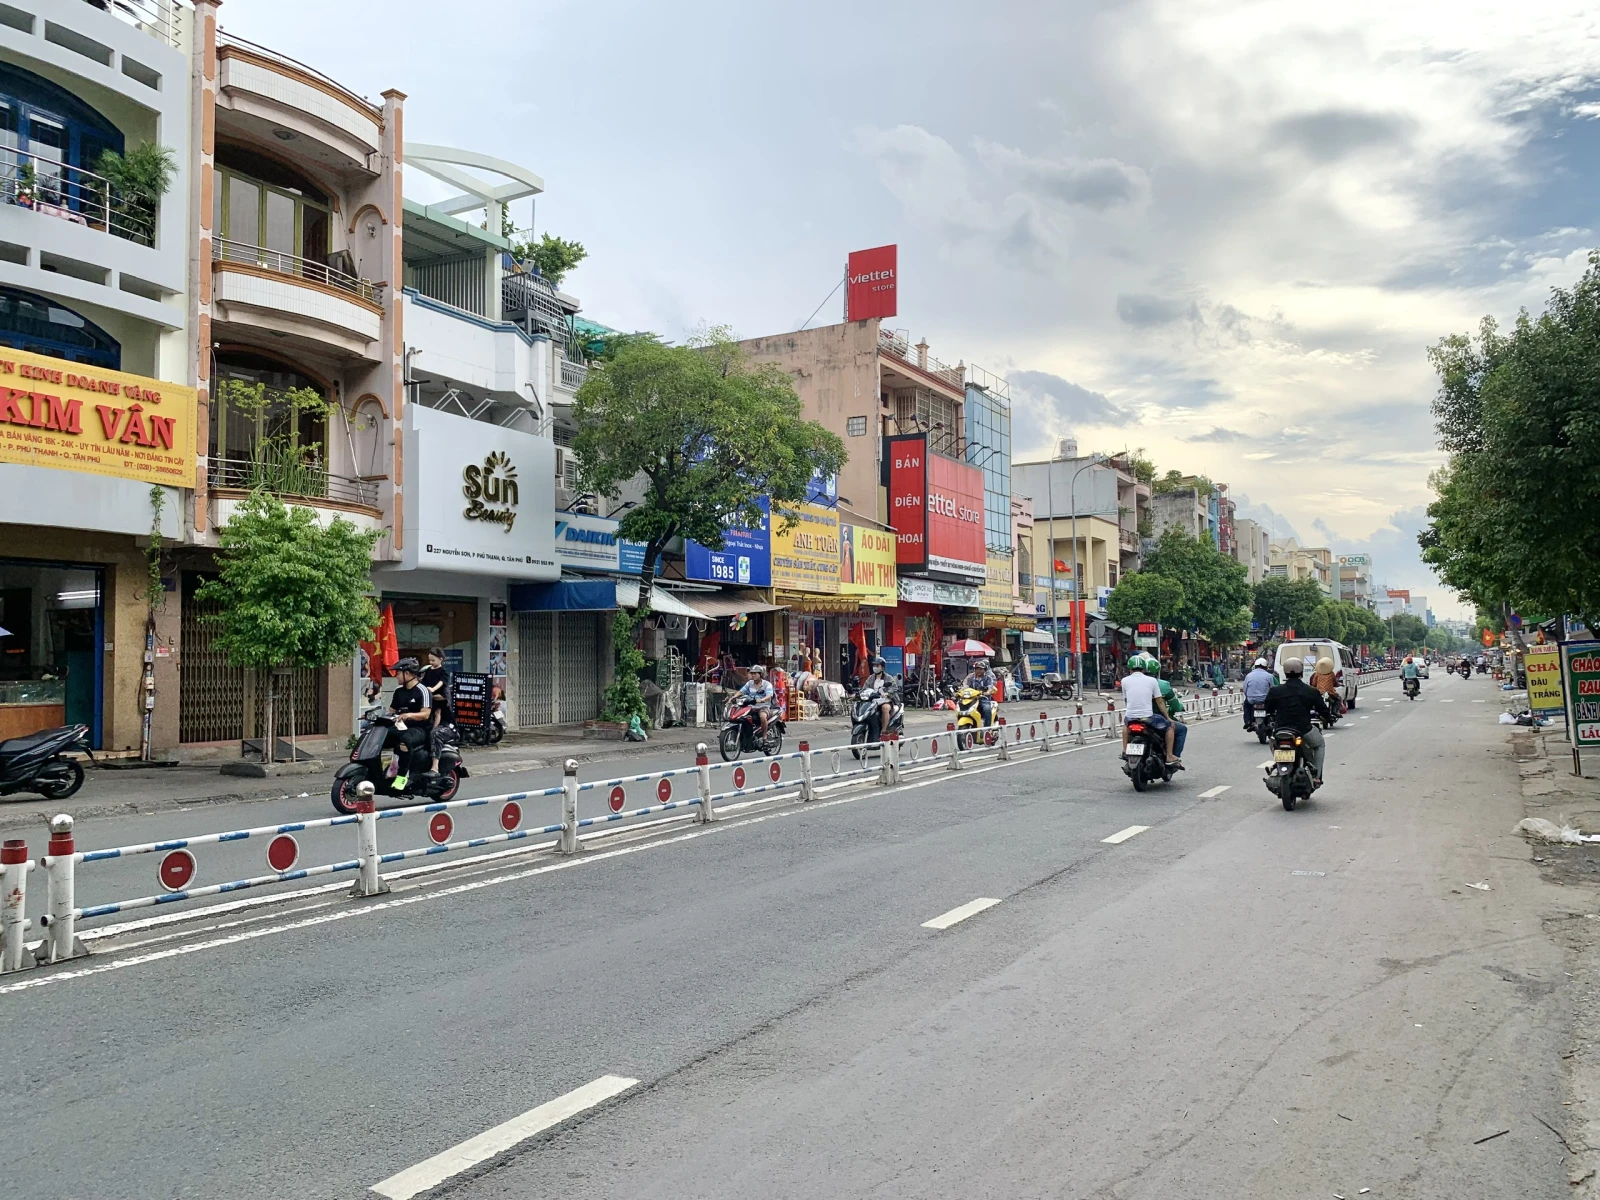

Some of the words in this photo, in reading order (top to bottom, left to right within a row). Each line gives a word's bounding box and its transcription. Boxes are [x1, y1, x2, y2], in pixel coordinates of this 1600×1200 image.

[849, 269, 895, 285] viettel
[872, 283, 895, 292] store
[21, 364, 63, 384] KINH
[67, 373, 120, 396] DOANH
[125, 384, 162, 404] VÀNG
[0, 386, 83, 435] KIM
[96, 403, 177, 450] VÂN
[6, 431, 22, 440] BÁN
[23, 432, 43, 443] VÀNG
[61, 440, 74, 448] 24K
[80, 443, 89, 451] UY
[33, 447, 58, 456] THẠNH
[72, 453, 86, 461] TÂN
[895, 454, 920, 469] BÁN
[463, 464, 519, 506] Sun
[895, 493, 921, 509] ĐIỆN
[928, 492, 957, 519] ettel
[959, 504, 980, 525] store
[463, 499, 517, 534] Beauty
[565, 527, 617, 547] DAIKIN
[793, 532, 813, 549] ANH
[861, 530, 873, 549] ÁO
[876, 533, 890, 553] DÀI
[711, 555, 725, 564] SINCE
[1347, 556, 1365, 564] OCB
[712, 564, 734, 579] 1985
[856, 561, 875, 587] ANH
[877, 563, 896, 588] THƯ
[1138, 623, 1158, 633] HOTEL
[1527, 660, 1559, 673] CHÁ
[1572, 653, 1600, 673] CHÁO
[1531, 677, 1548, 687] ĐẬU
[1575, 697, 1598, 720] BÁNH
